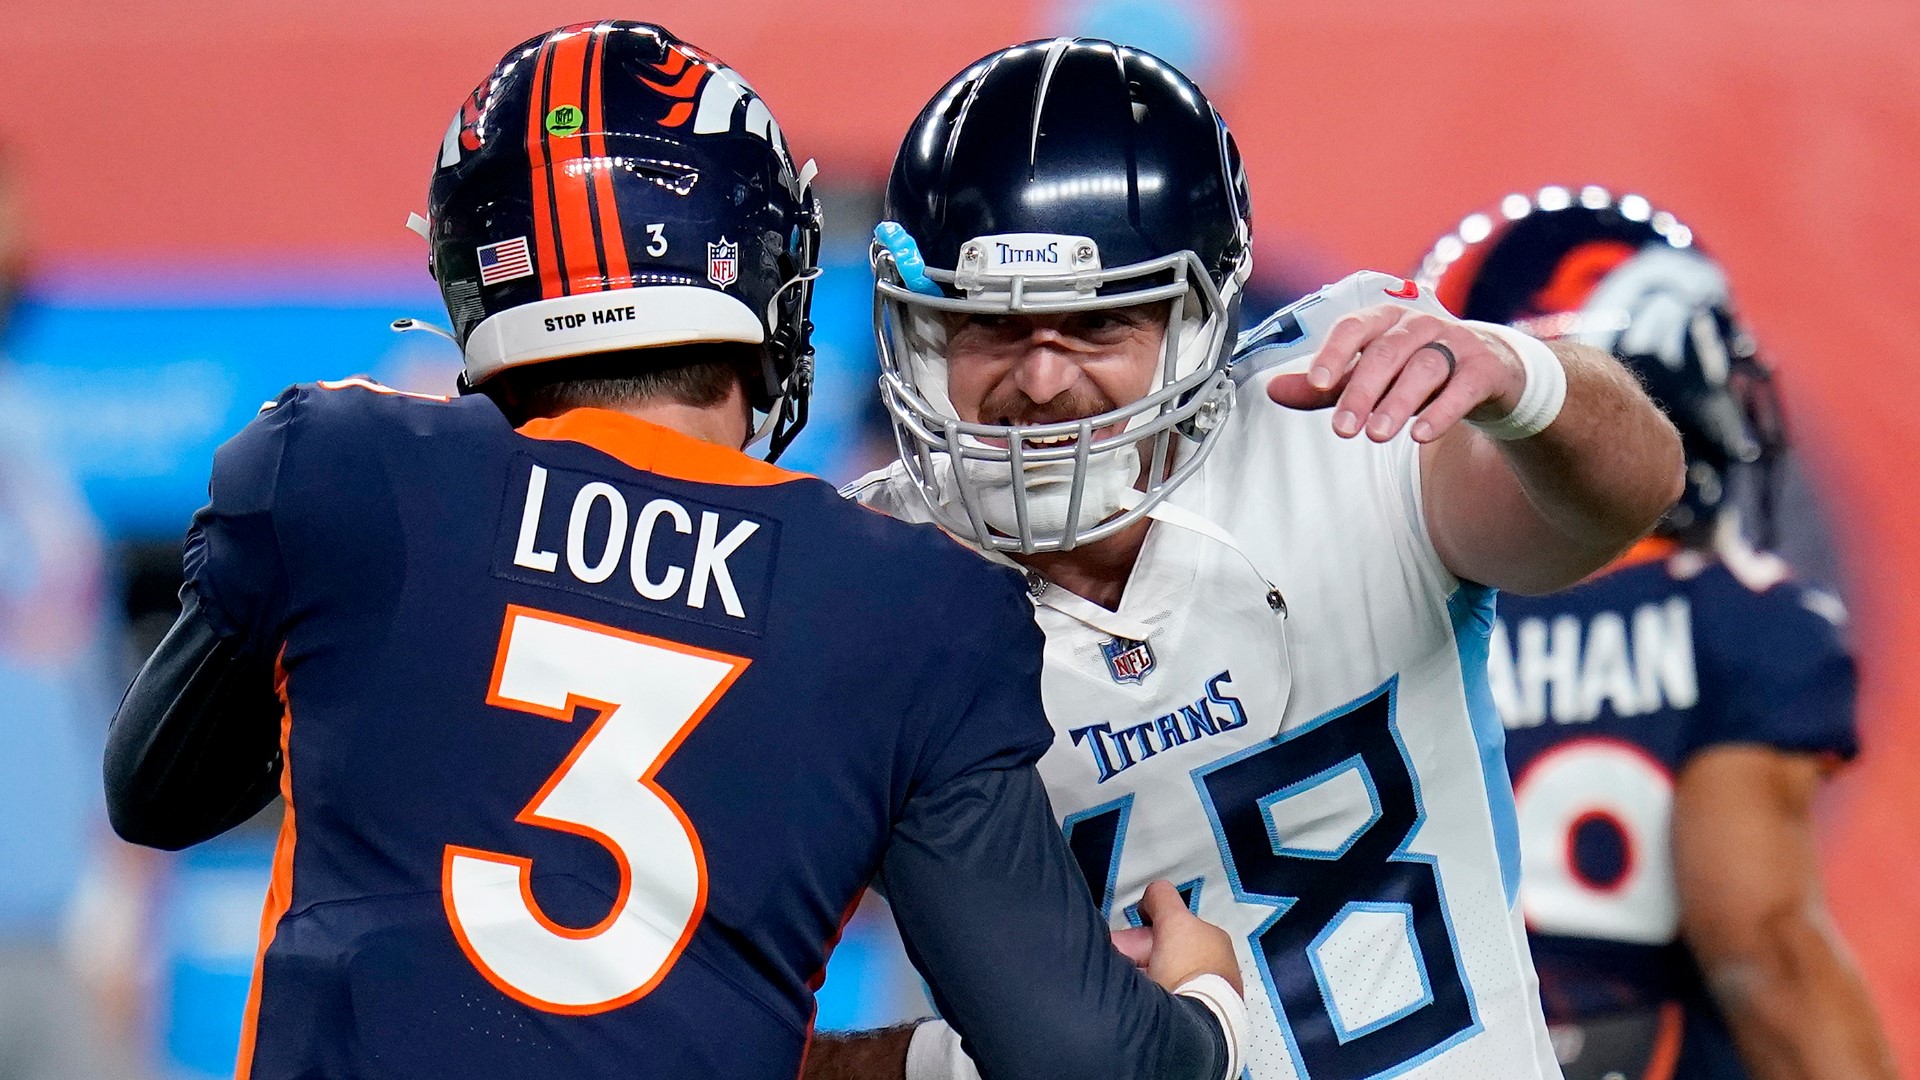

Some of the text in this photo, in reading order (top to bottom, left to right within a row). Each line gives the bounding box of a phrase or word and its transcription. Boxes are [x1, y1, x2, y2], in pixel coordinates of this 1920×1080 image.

[646, 223, 668, 257] 3
[996, 241, 1058, 265] TITANS
[712, 260, 734, 280] NFL
[544, 306, 636, 332] STOP HATE
[513, 464, 760, 619] LOCK
[1113, 648, 1150, 677] NFL
[1070, 669, 1248, 784] TITANS
[441, 603, 752, 1016] 3
